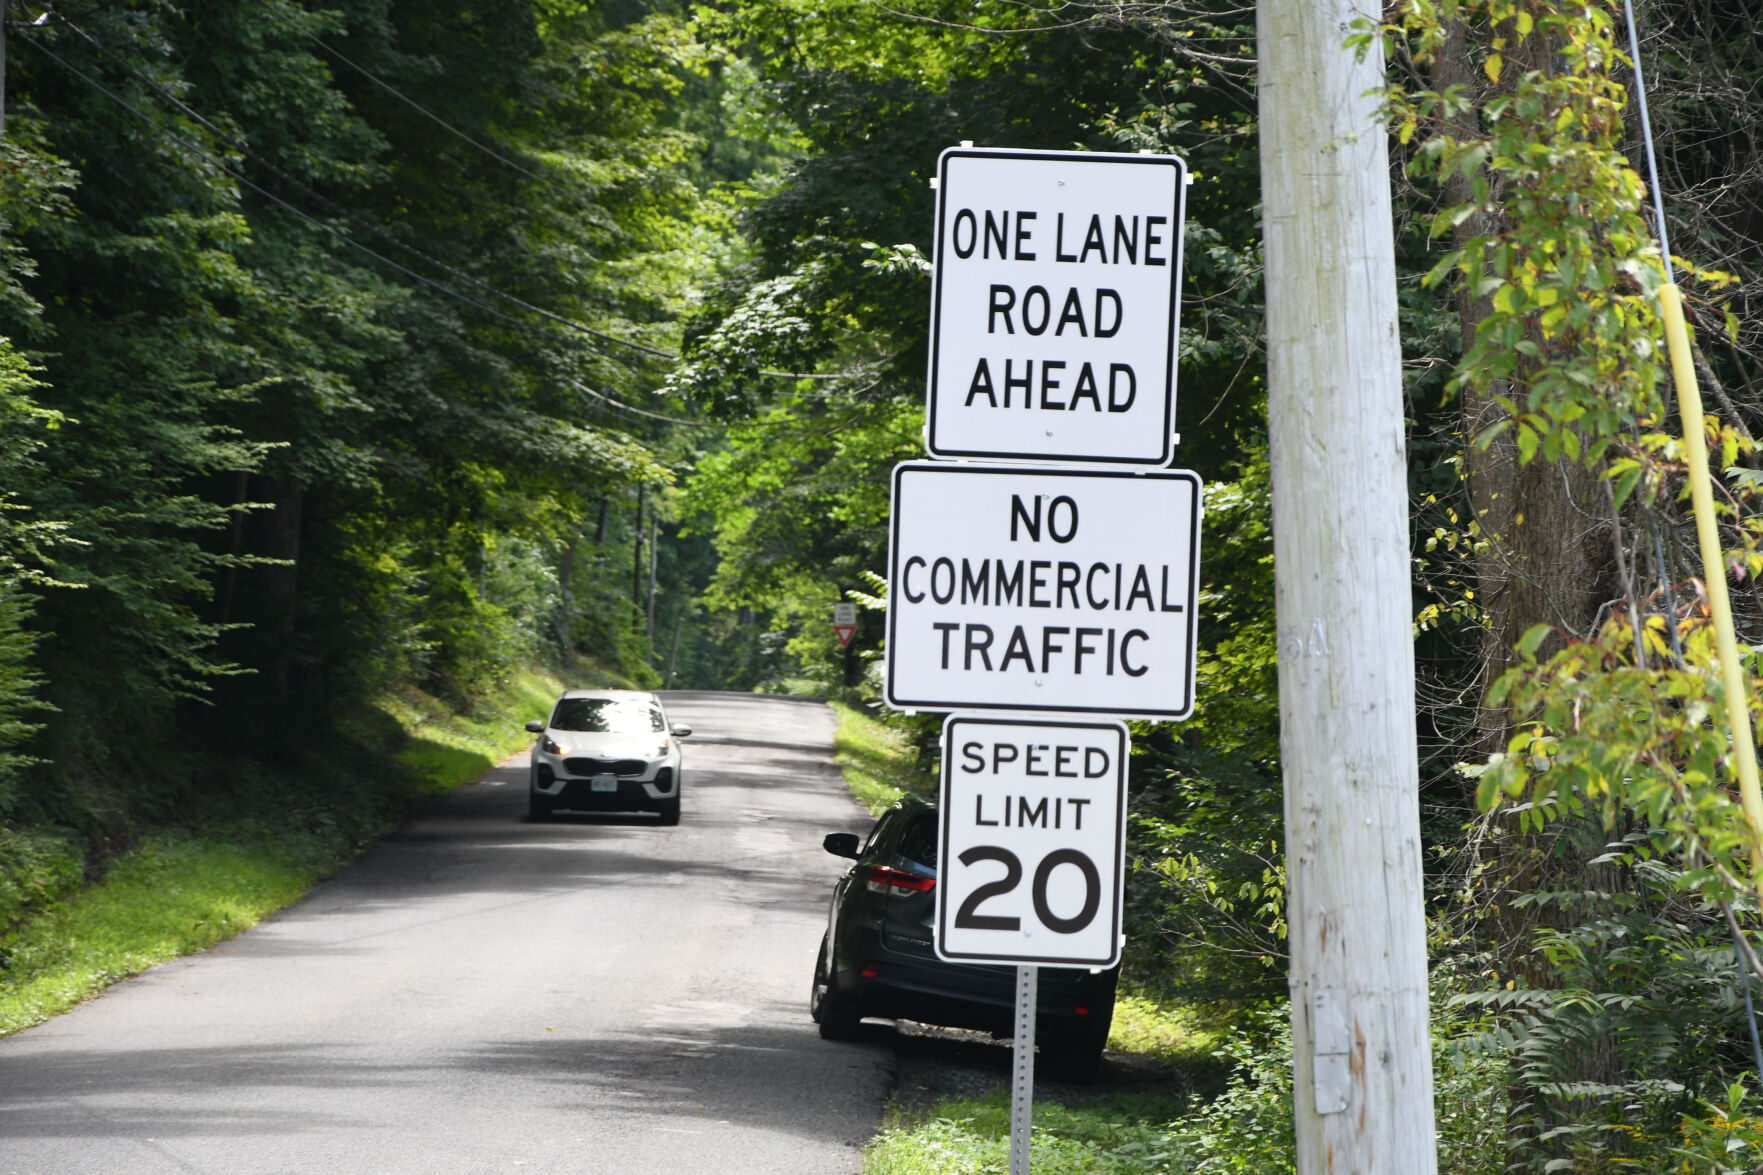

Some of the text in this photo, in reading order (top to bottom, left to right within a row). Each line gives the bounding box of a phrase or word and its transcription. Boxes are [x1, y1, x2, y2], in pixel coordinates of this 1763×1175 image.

[952, 208, 1168, 267] ONE LANE
[988, 283, 1123, 339] ROAD
[964, 357, 1137, 413] AHEAD
[1010, 494, 1079, 544] NO
[902, 555, 1183, 613] COMMERCIAL
[933, 622, 1150, 678] TRAFFIC
[960, 741, 1110, 779] SPEED
[975, 794, 1091, 830] LIMIT
[954, 845, 1101, 935] 20
